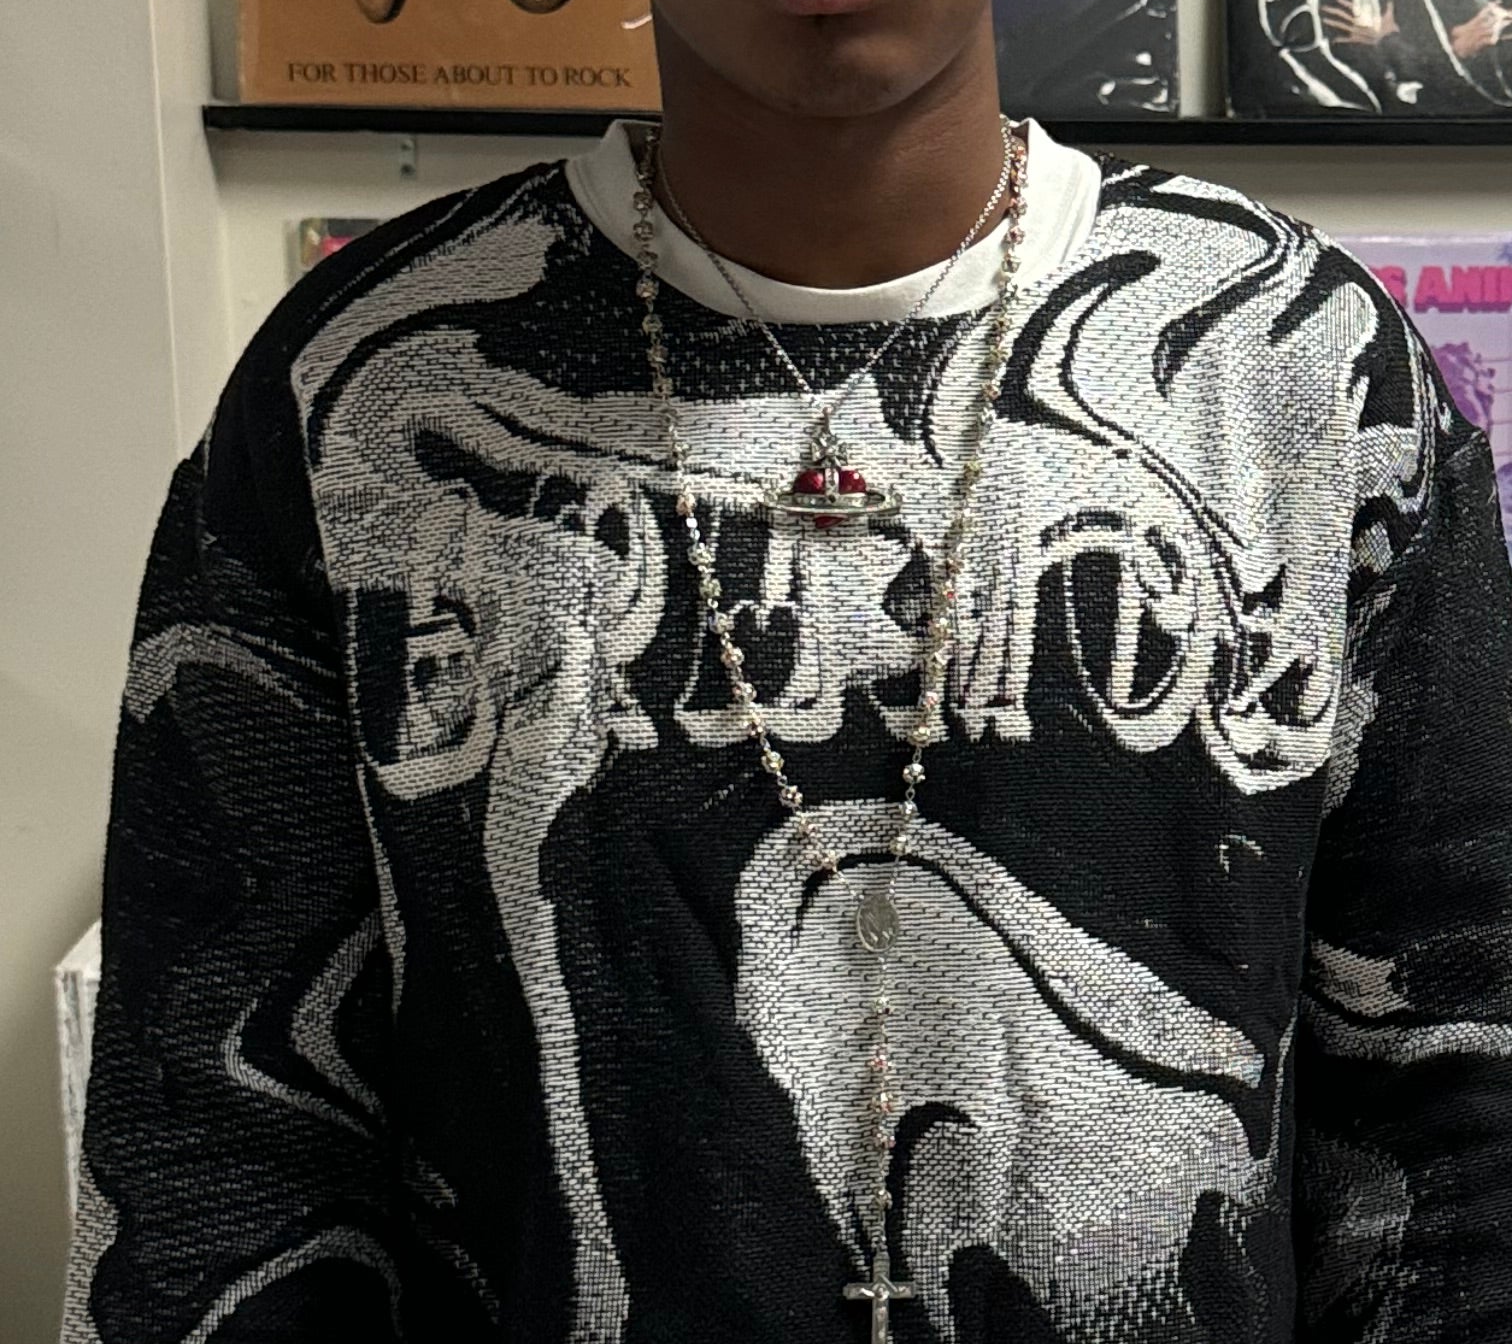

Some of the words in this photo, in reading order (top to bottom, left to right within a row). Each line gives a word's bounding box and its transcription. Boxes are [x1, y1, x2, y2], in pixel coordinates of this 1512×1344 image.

[288, 62, 337, 85] FOR
[344, 63, 427, 85] THOSE
[433, 64, 517, 86] ABOUT
[525, 65, 558, 86] TO
[565, 66, 633, 89] ROCK
